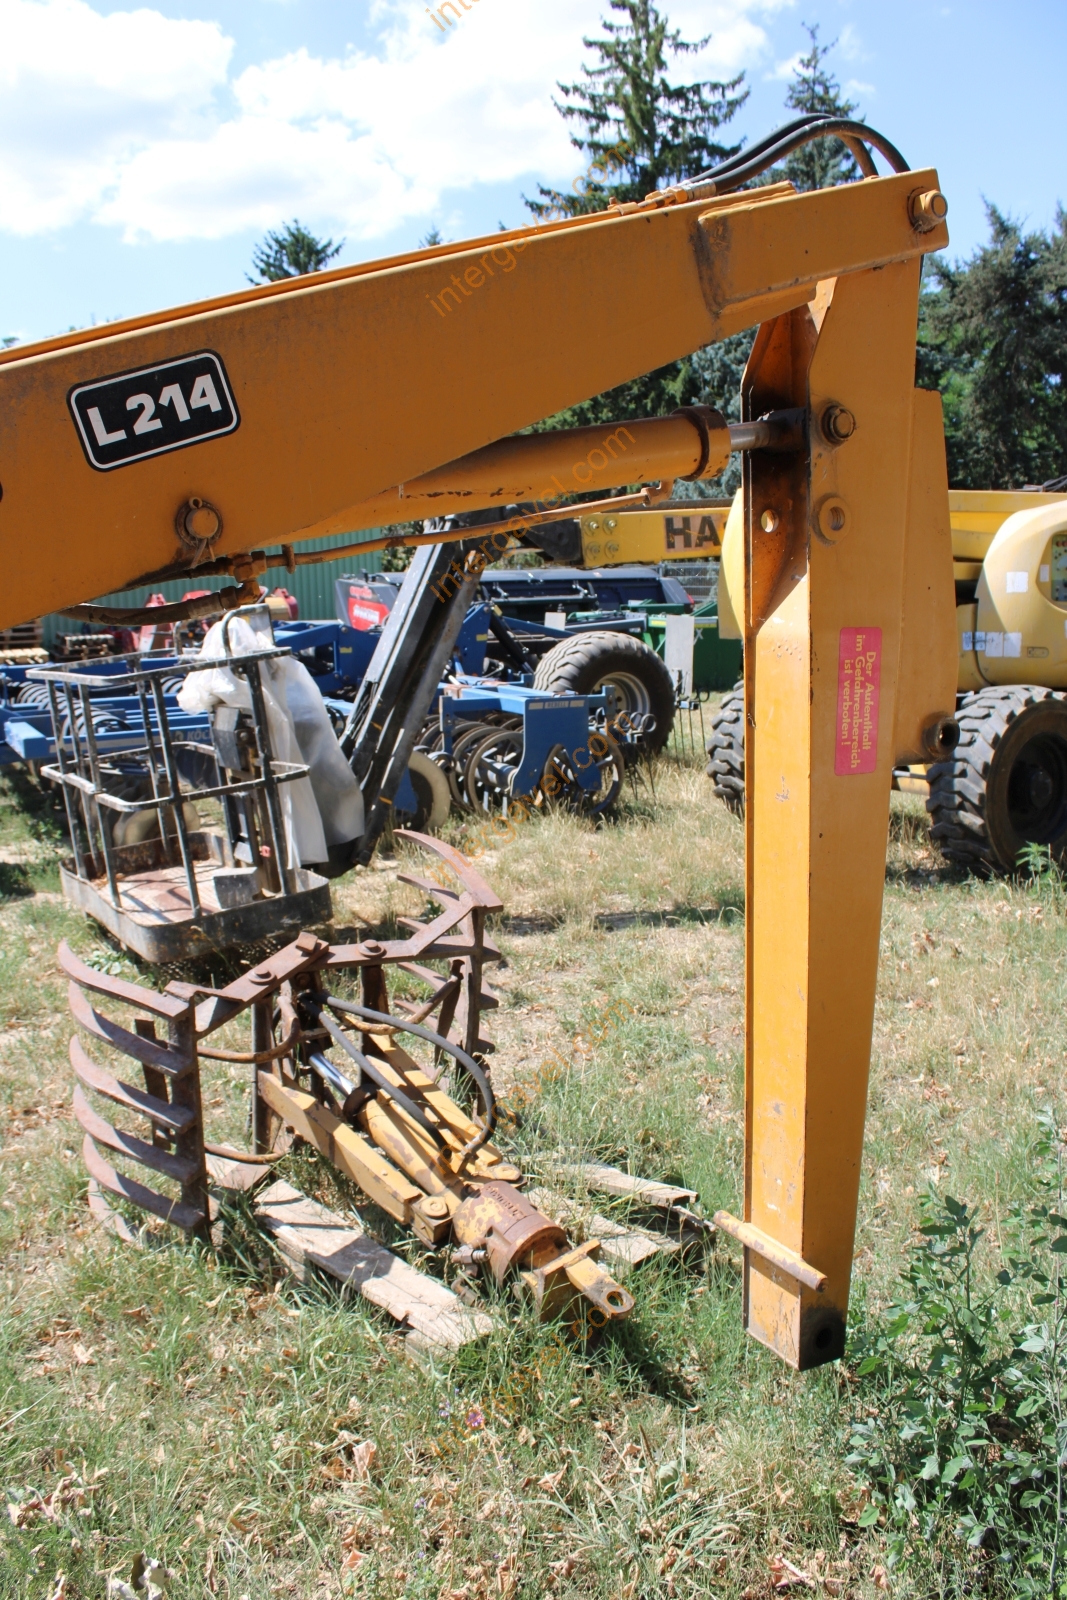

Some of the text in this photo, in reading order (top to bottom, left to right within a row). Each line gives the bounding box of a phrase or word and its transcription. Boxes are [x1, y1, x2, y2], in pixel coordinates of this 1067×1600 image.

[86, 373, 223, 447] L214
[664, 515, 728, 549] HA
[844, 659, 853, 674] ist
[850, 634, 866, 769] im Gefahrenbereich
[862, 651, 877, 751] Der Aufenthalt
[186, 728, 211, 741] KÖC
